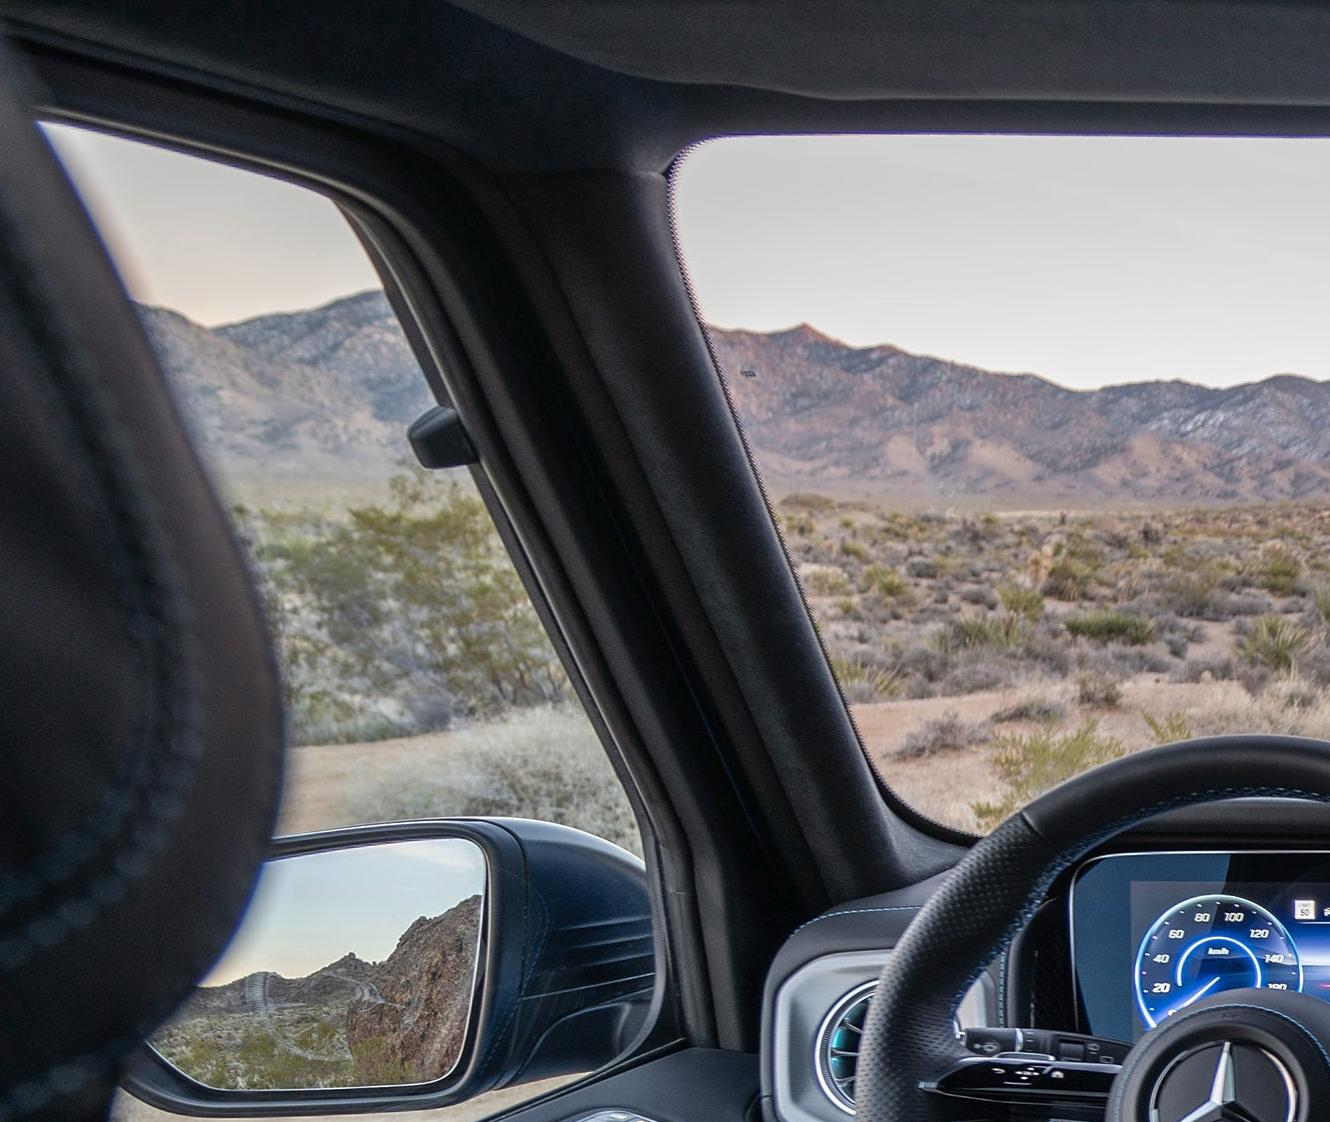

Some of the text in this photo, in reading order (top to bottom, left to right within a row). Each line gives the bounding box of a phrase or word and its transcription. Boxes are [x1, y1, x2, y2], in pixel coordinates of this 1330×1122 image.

[1194, 913, 1211, 922] 80
[1224, 912, 1244, 922] 100
[1168, 929, 1185, 939] 60
[1250, 929, 1269, 939] 120
[1153, 954, 1170, 963] 40
[1265, 954, 1284, 963] 140
[1152, 983, 1171, 993] 20
